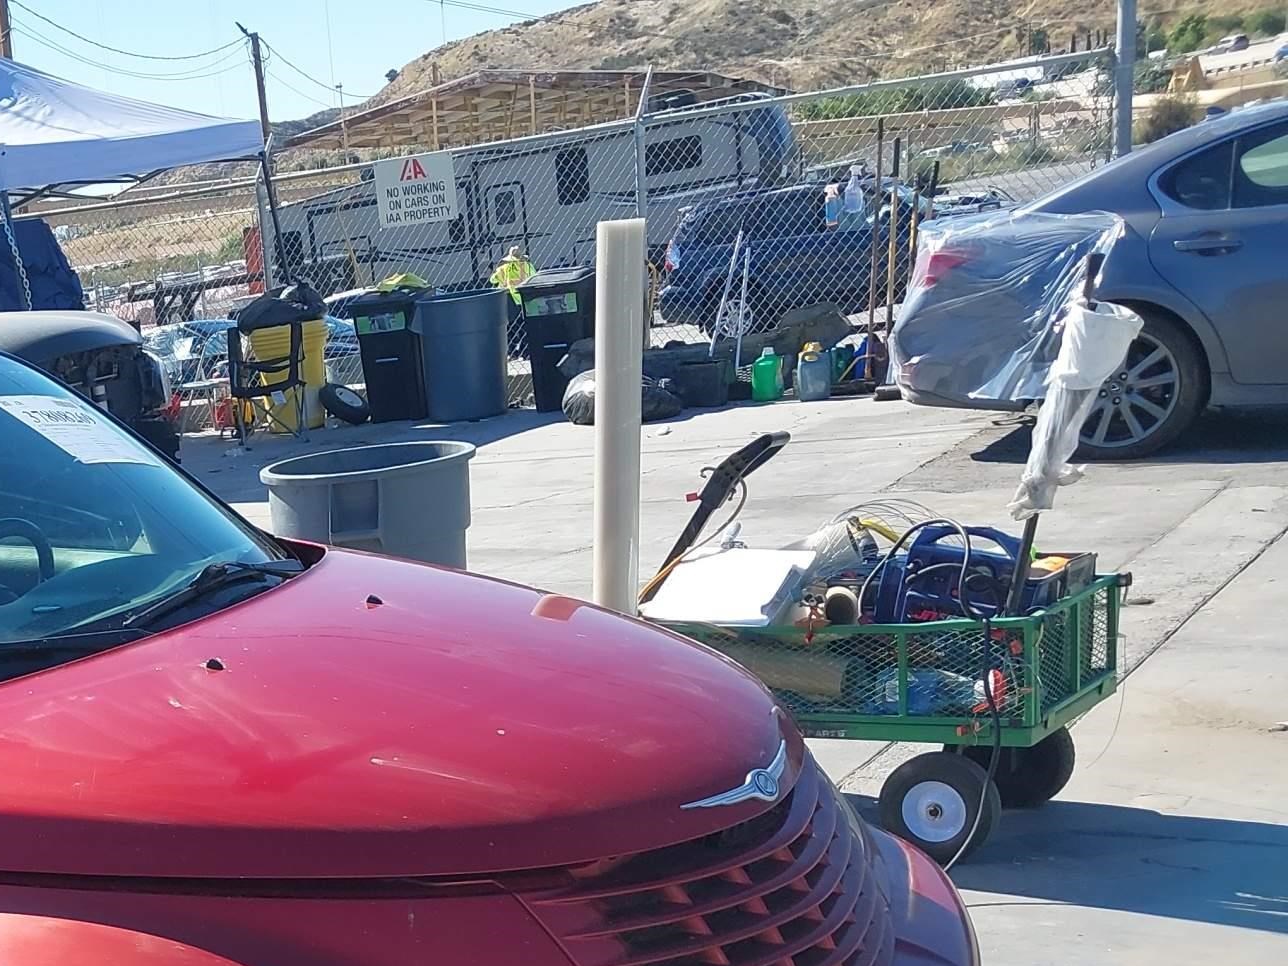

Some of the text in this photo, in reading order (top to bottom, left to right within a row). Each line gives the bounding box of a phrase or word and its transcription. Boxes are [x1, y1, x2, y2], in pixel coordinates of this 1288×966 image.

[386, 181, 446, 198] NO WORKING
[389, 193, 446, 211] ON CARS ON
[386, 206, 451, 224] IAA PROPERTY
[22, 409, 97, 425] 37808269
